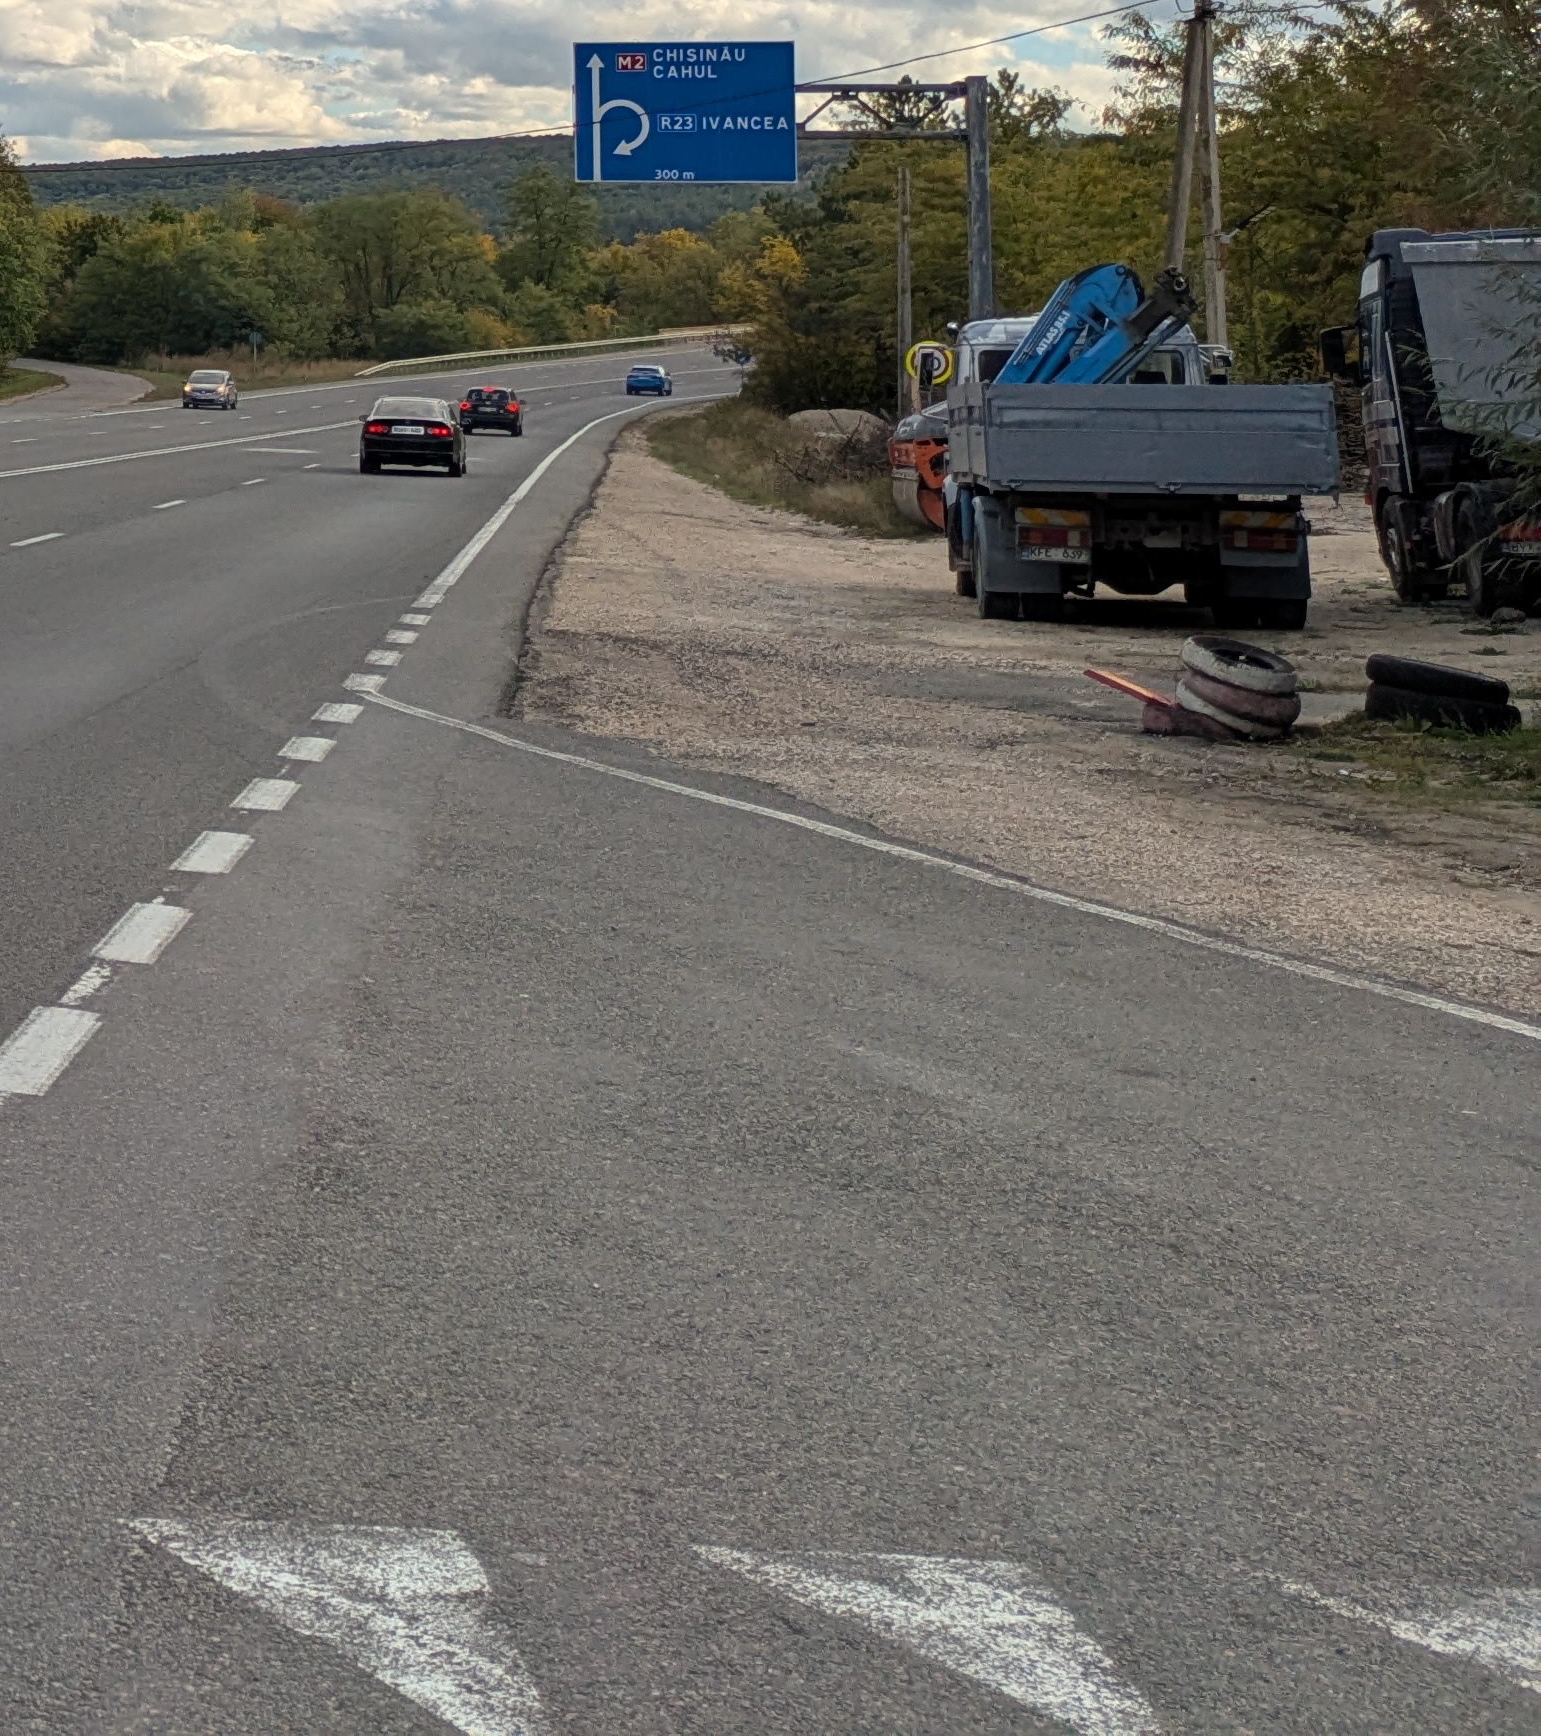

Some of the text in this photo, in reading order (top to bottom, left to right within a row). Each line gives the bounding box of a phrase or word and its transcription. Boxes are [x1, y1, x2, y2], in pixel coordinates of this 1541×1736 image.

[618, 56, 644, 69] M2
[653, 65, 718, 78] CAHUL
[661, 116, 789, 130] R23 IVANCEA
[655, 169, 695, 180] 300 m
[1036, 326, 1058, 356] ATLAS
